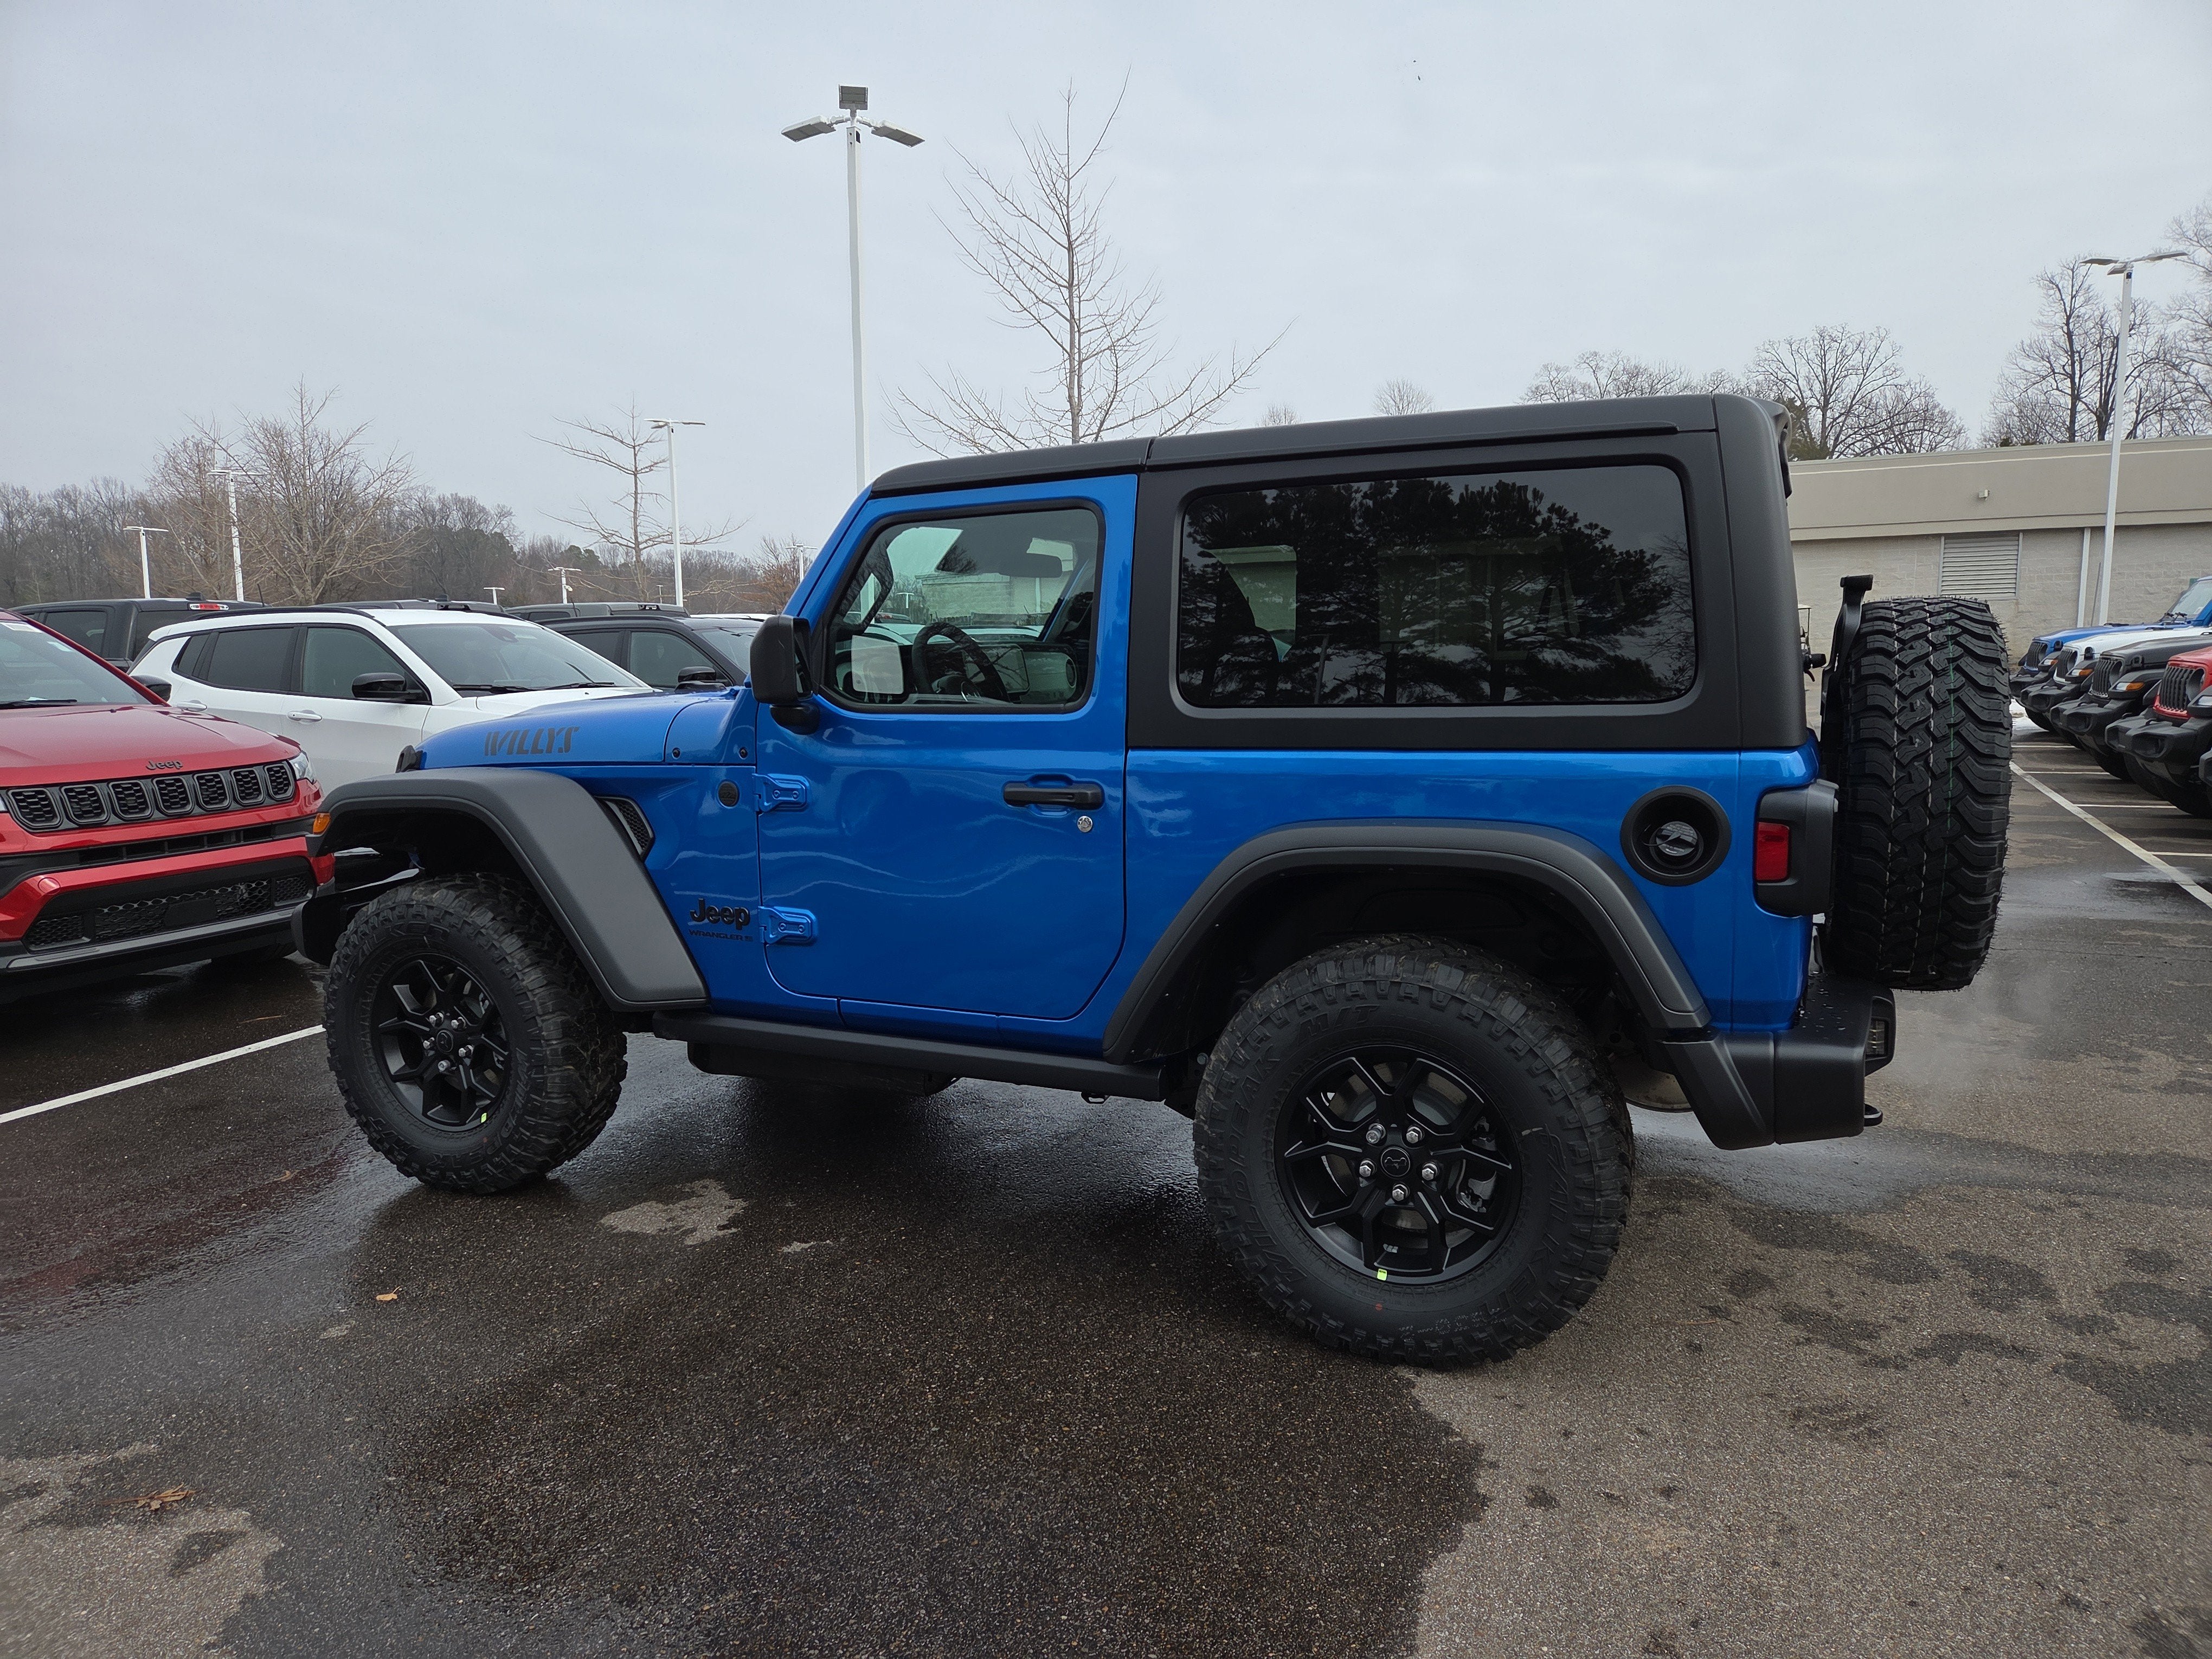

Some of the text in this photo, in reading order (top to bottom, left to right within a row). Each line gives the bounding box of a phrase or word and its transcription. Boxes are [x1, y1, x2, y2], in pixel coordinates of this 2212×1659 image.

[485, 726, 580, 756] WILLYS
[145, 760, 183, 770] Jeep
[690, 898, 750, 930] Jeep
[689, 929, 744, 941] WRANGLER
